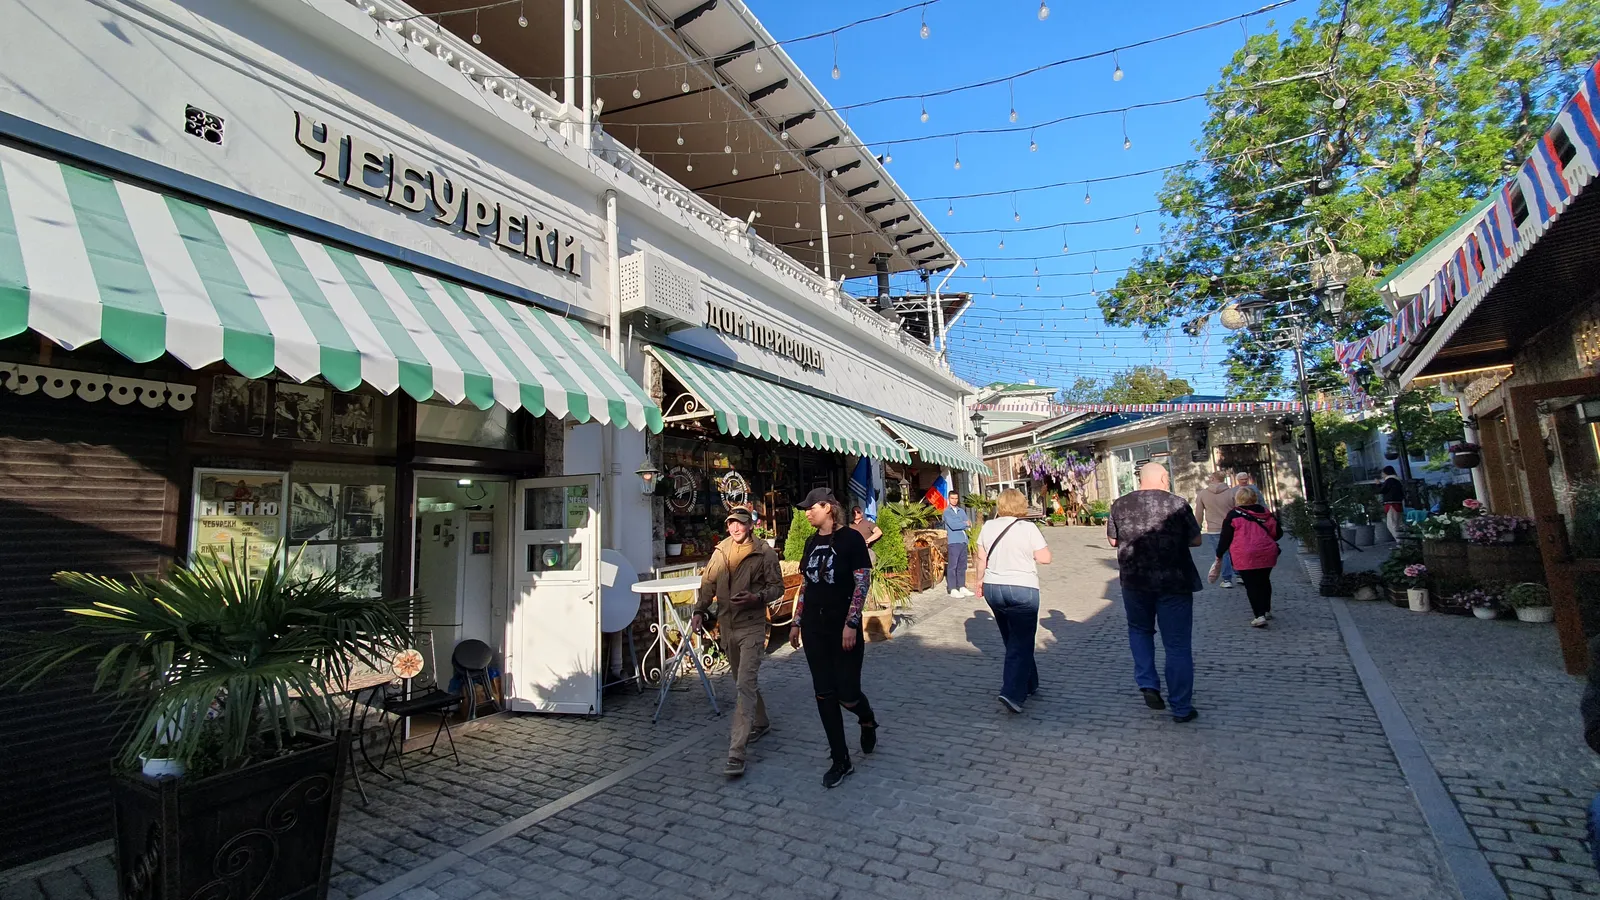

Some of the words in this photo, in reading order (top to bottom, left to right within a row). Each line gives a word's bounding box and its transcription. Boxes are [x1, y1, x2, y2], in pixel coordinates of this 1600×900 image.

[294, 111, 584, 277] ЧЕБУРЕКИ
[706, 301, 747, 340] ДОМ
[752, 320, 825, 370] ПРИРОДЫ
[200, 501, 279, 516] МЕНЮ
[202, 520, 237, 528] ЧЕБУРЕКИ
